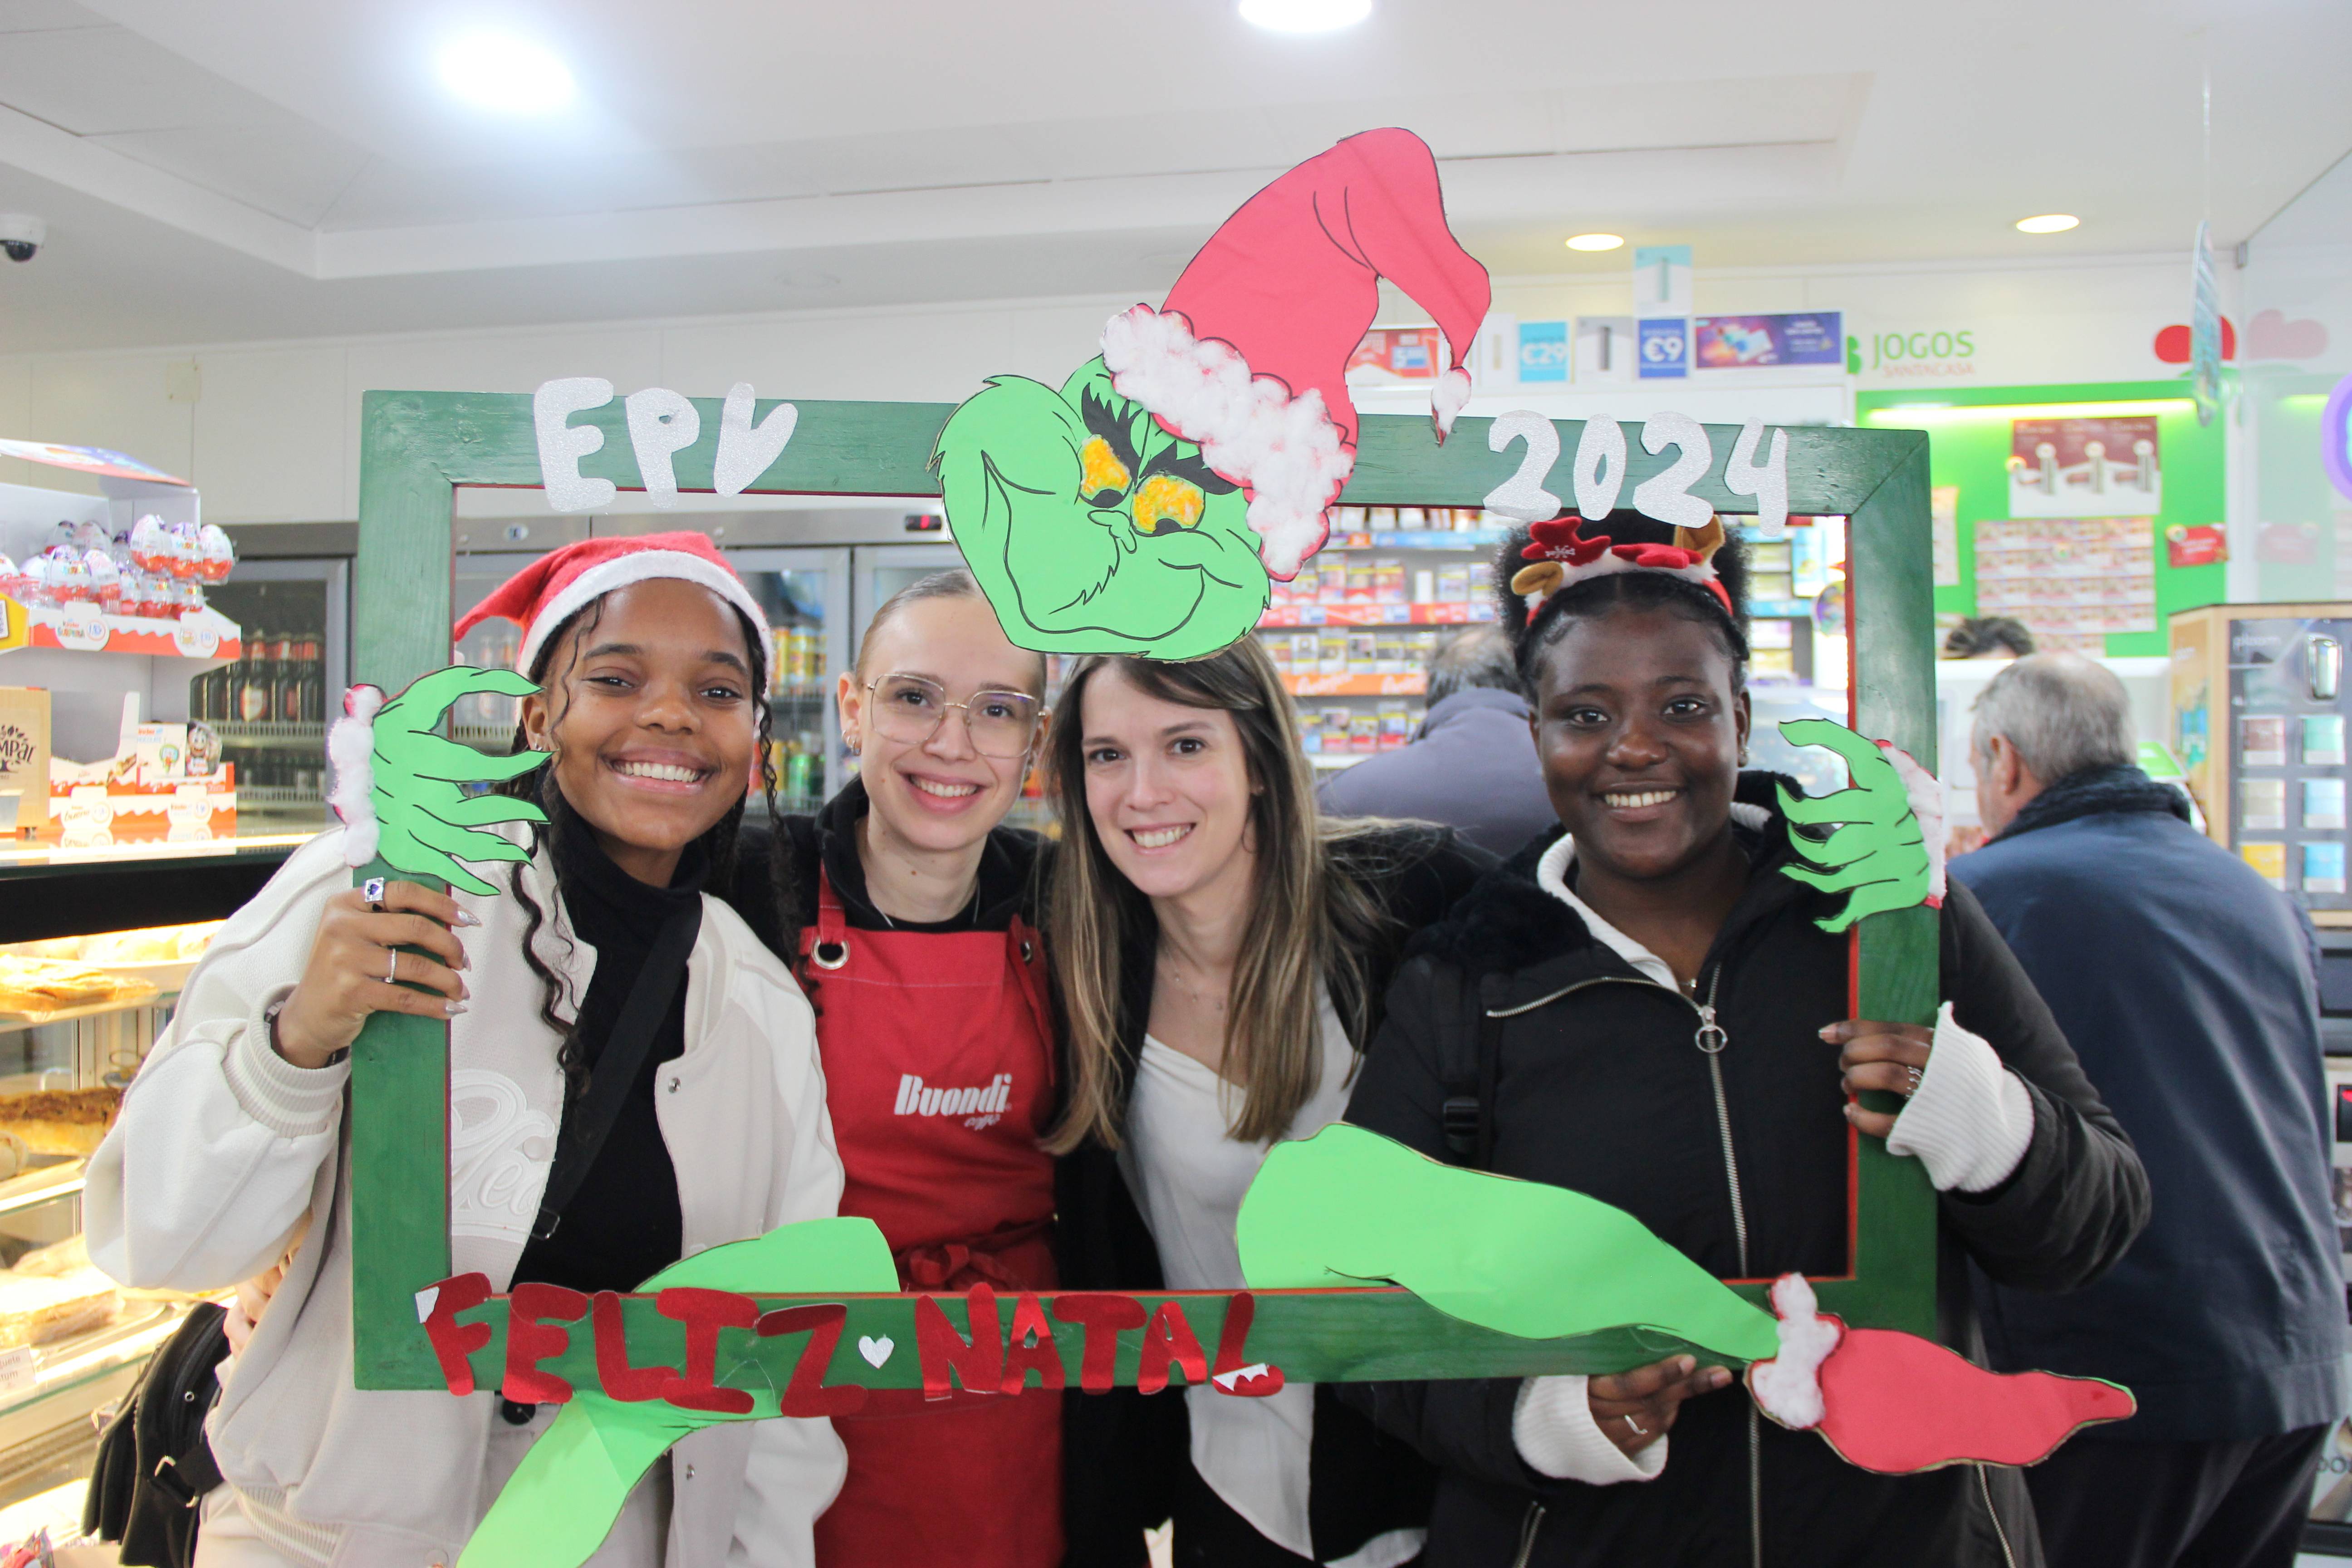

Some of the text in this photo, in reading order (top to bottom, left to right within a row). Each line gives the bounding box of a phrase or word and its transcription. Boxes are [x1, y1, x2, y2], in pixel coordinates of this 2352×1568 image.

[1643, 336, 1685, 362] €9
[1871, 331, 1975, 370] JOGOS
[533, 377, 799, 512] EPV
[1483, 409, 1788, 537] 2024
[894, 1073, 1012, 1117] Buondi
[416, 1272, 1285, 1418] FELIZ NATAL
